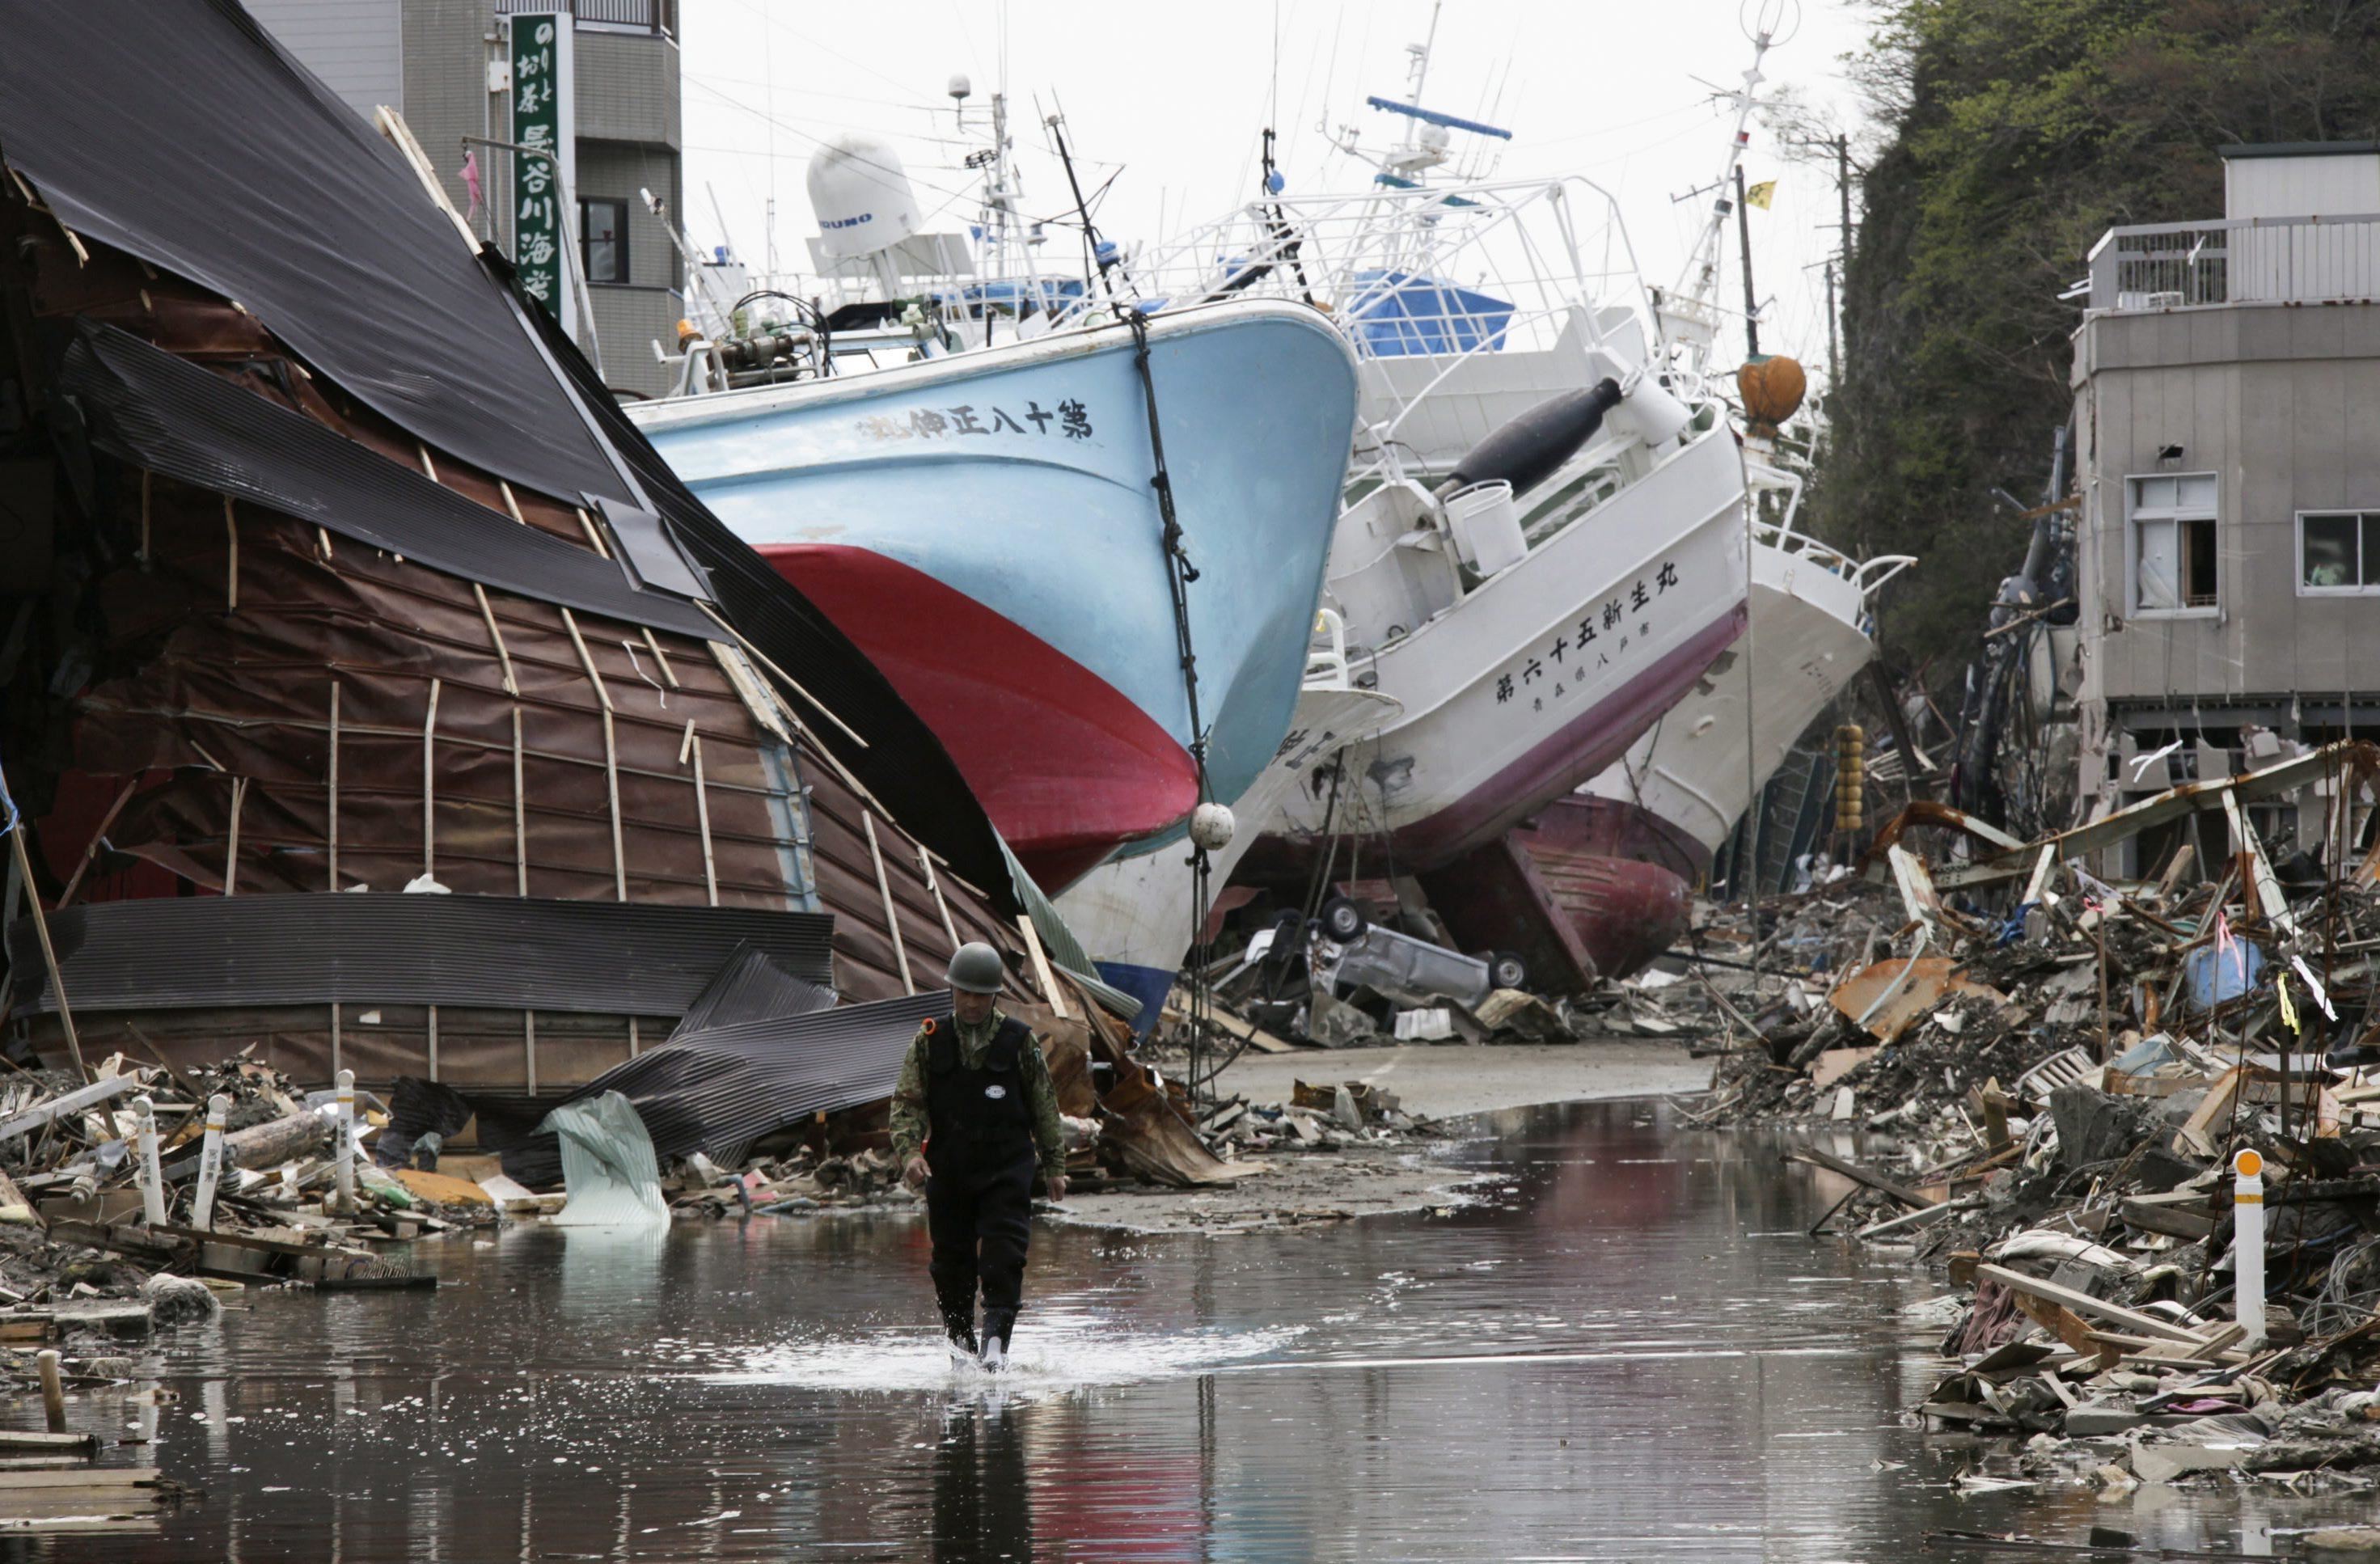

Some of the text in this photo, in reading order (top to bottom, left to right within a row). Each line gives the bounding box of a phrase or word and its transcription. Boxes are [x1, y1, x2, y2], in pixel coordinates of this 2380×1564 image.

[516, 54, 541, 114] お茶
[535, 23, 554, 102] のりと
[518, 124, 559, 319] 長谷川海苔
[1496, 561, 1679, 705] 第六十五新生丸
